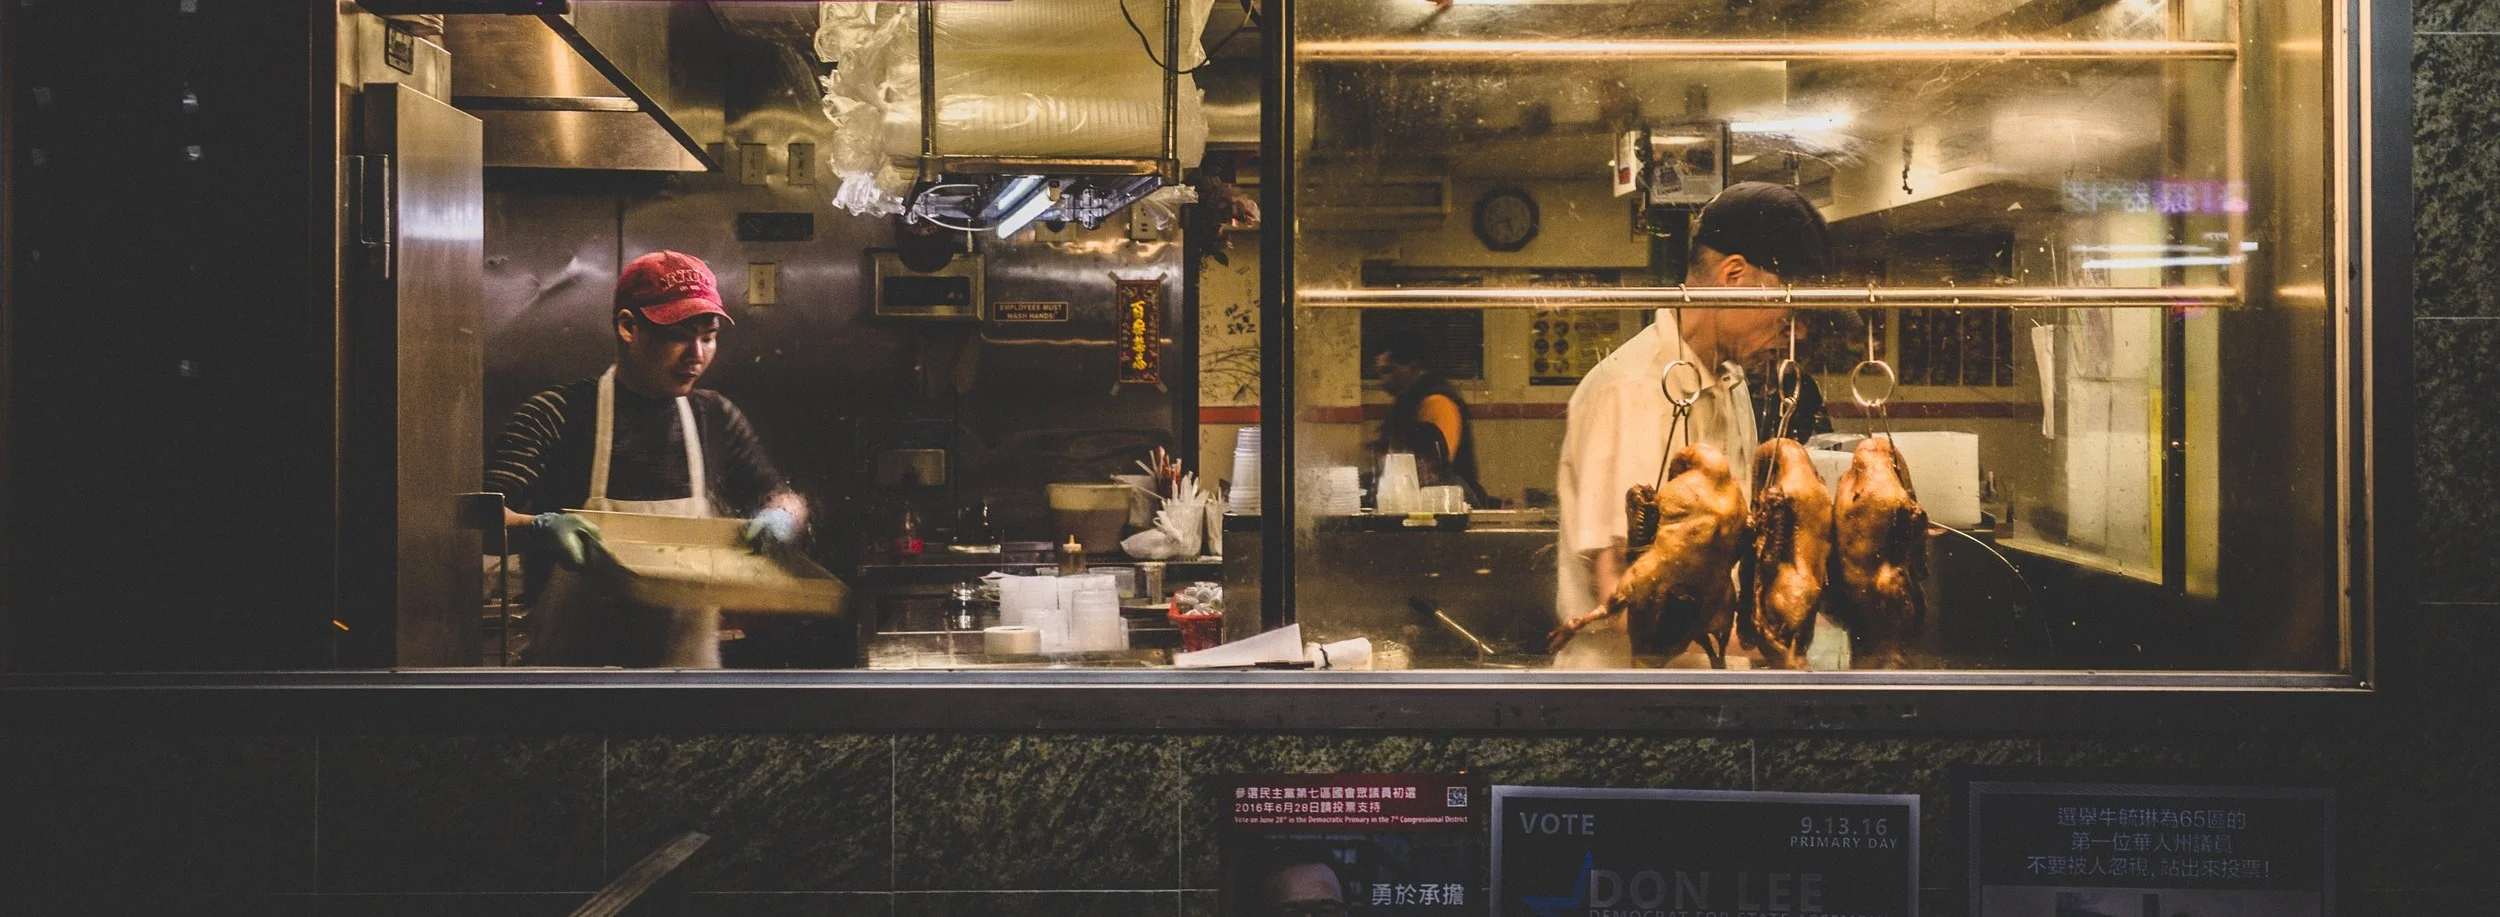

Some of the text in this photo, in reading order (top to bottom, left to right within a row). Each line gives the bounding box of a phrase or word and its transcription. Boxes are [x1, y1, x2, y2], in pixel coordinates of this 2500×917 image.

[1235, 801, 1380, 813] 2016年6月28日請投票支持
[1234, 815, 1248, 824] Vote
[1259, 816, 1274, 824] June
[1308, 815, 1343, 823] Democratic
[1344, 815, 1370, 825] Primary
[1400, 815, 1444, 825] Congressional
[1445, 815, 1468, 824] District
[1519, 812, 1595, 835] VOTE
[1800, 816, 1888, 836] 9.13.16
[1790, 835, 1898, 850] PRIMARY DAY
[2071, 832, 2233, 854] 第一位華人州議員
[1371, 883, 1465, 905] 勇於承擔
[1590, 868, 1825, 913] DON LEE
